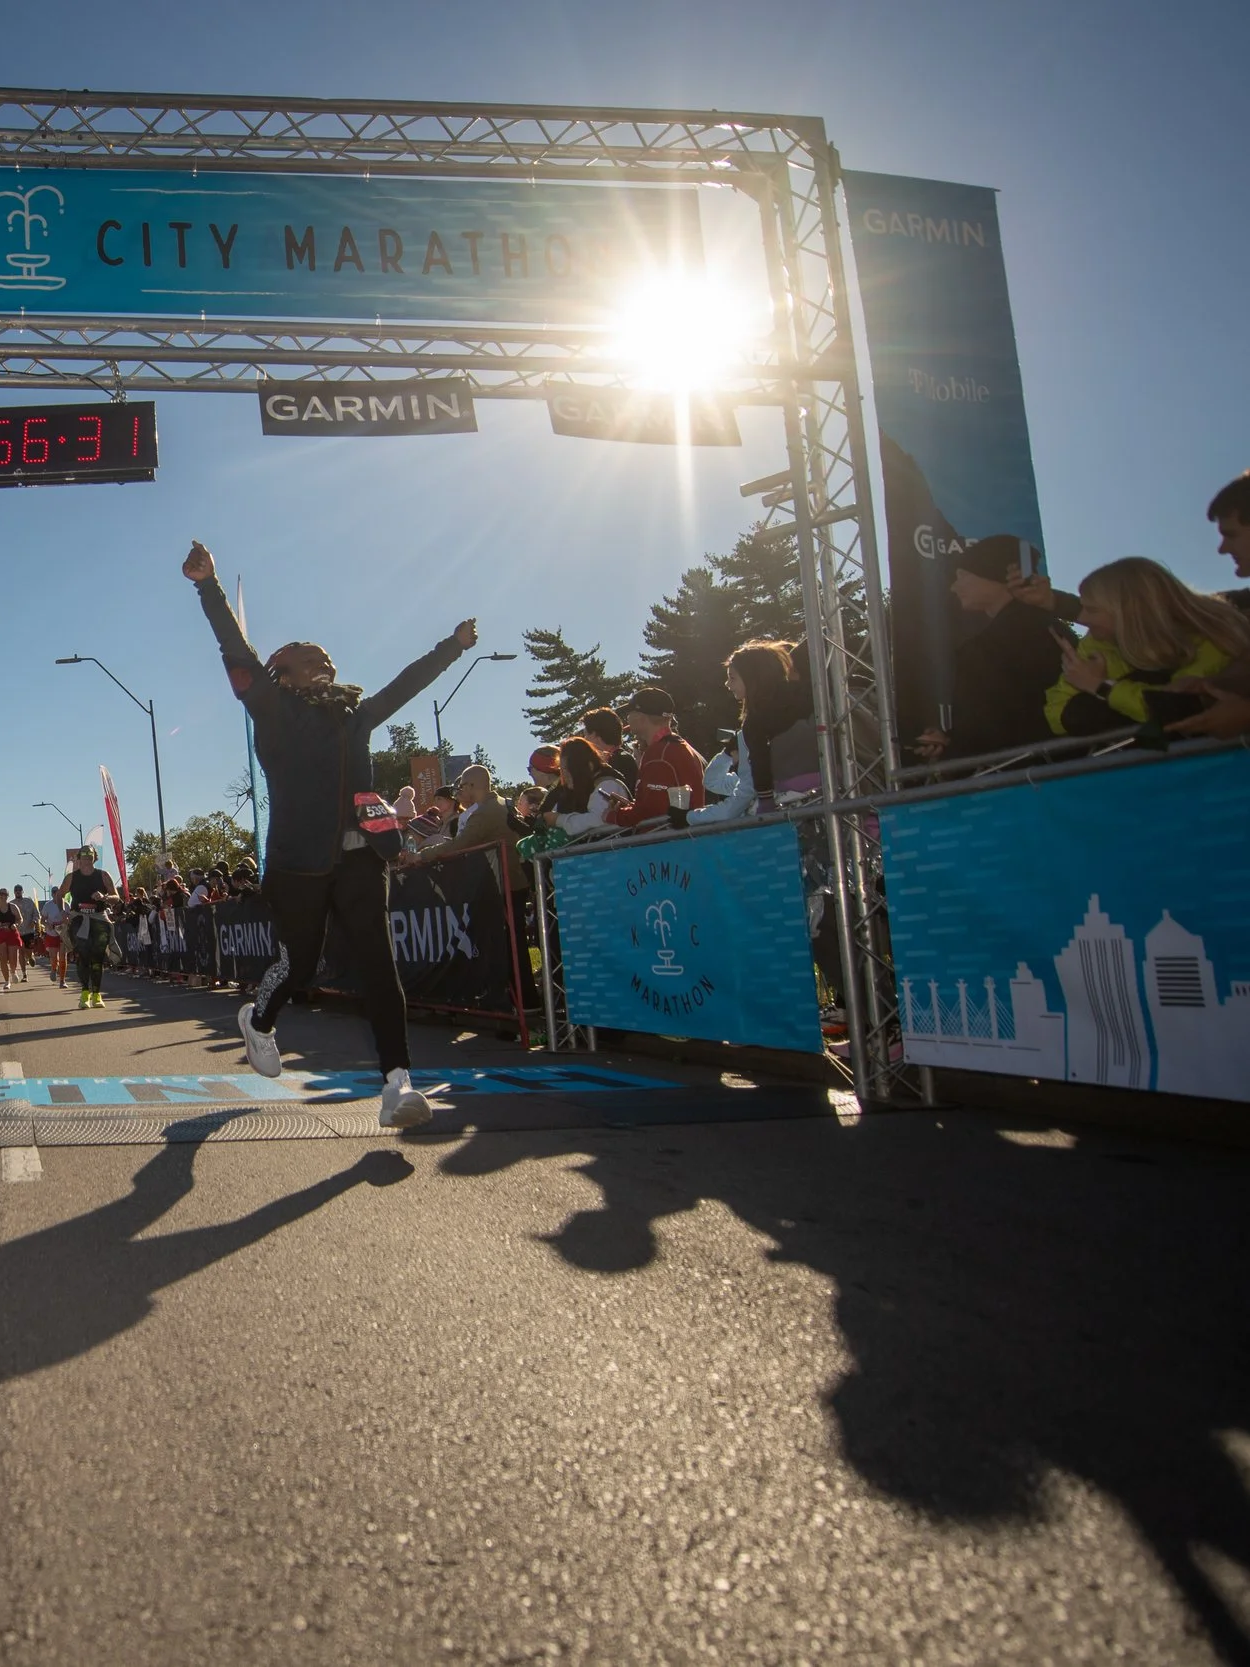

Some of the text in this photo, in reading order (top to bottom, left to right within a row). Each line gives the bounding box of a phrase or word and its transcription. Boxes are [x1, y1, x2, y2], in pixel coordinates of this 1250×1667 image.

[862, 208, 985, 248] GARMIN
[96, 219, 240, 269] CITY
[284, 226, 616, 280] MARATHO
[264, 391, 461, 424] GARMIN
[626, 861, 691, 896] GARMIN
[219, 920, 272, 957] GARMIN
[390, 902, 473, 963] RMIN
[690, 924, 700, 946] C
[630, 973, 716, 1017] MARATHON
